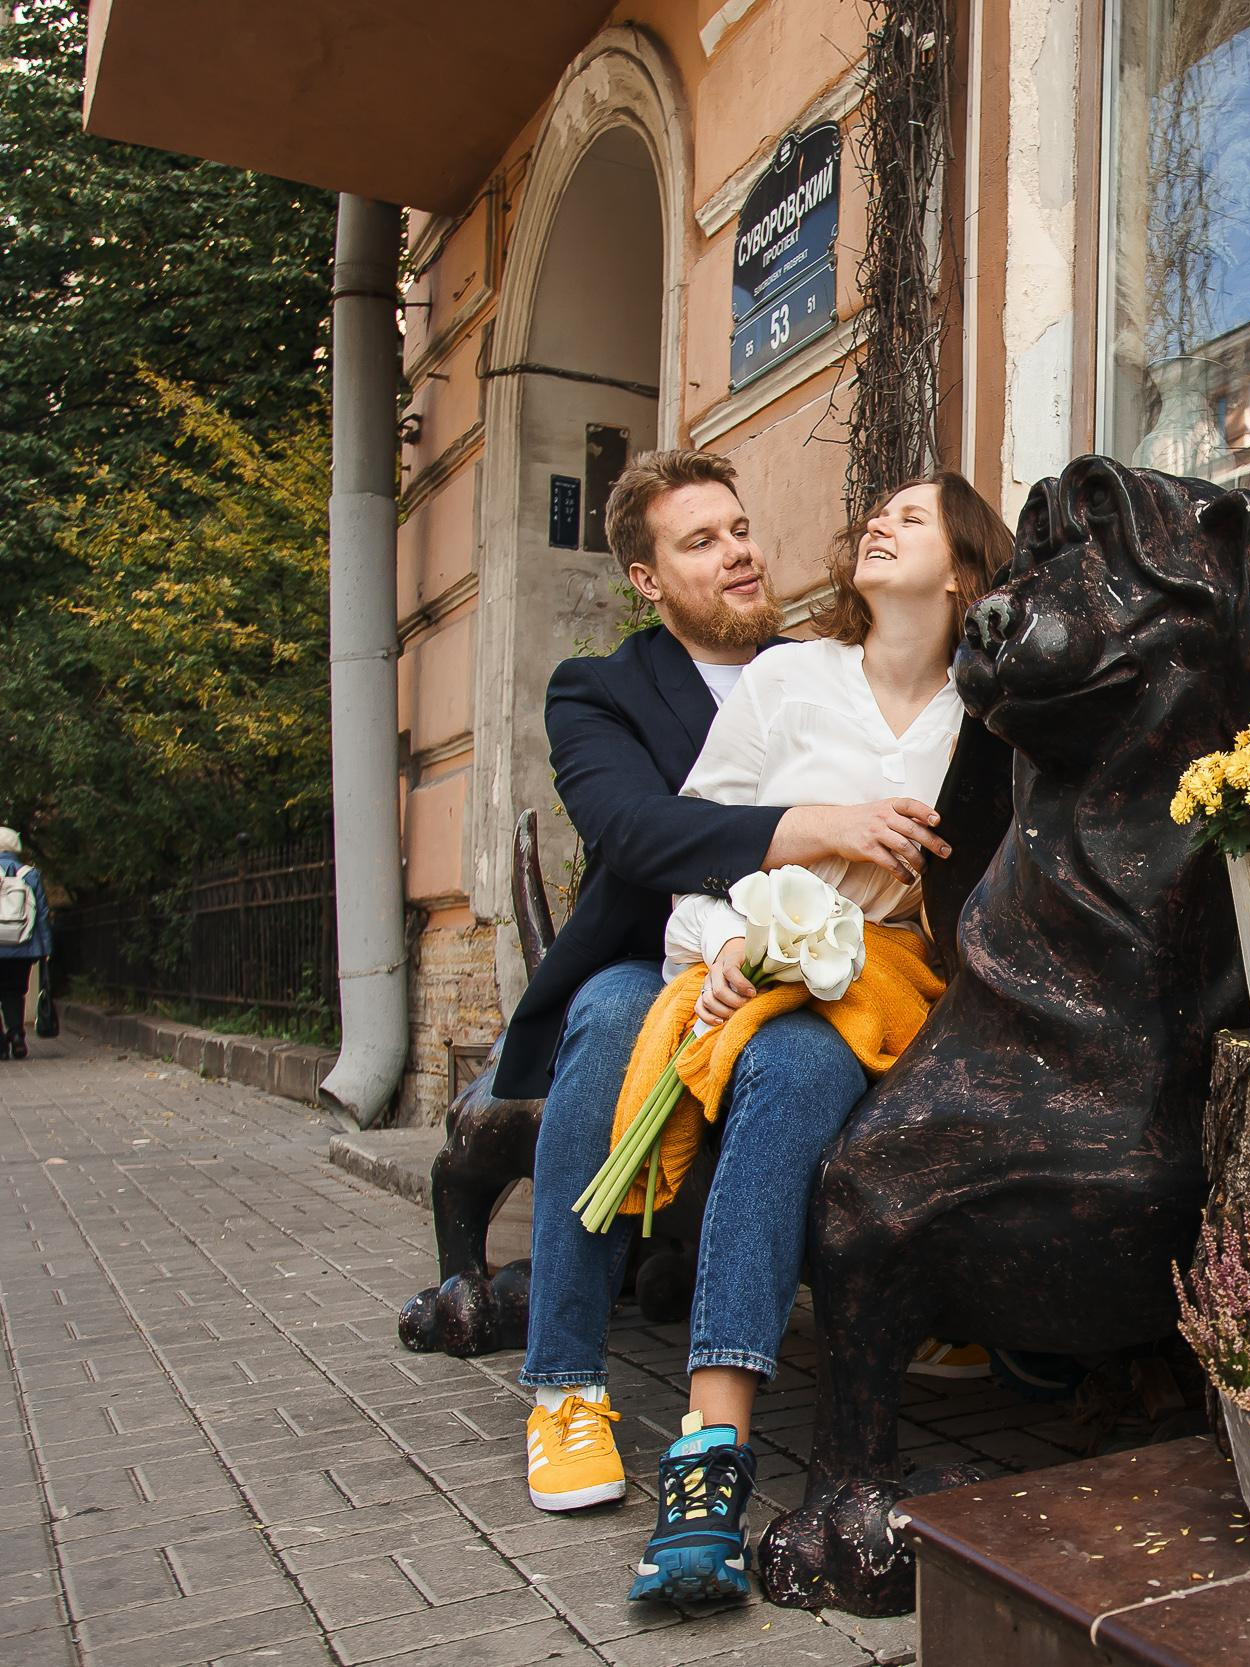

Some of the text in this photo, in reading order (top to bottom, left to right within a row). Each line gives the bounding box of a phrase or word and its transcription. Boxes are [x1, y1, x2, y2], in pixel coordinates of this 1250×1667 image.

[737, 155, 833, 267] СУВОРОВСКИЙ
[762, 227, 800, 268] ПРОСПЕКТ
[783, 248, 808, 273] PROSPEKT
[745, 294, 816, 358] 55 53 51
